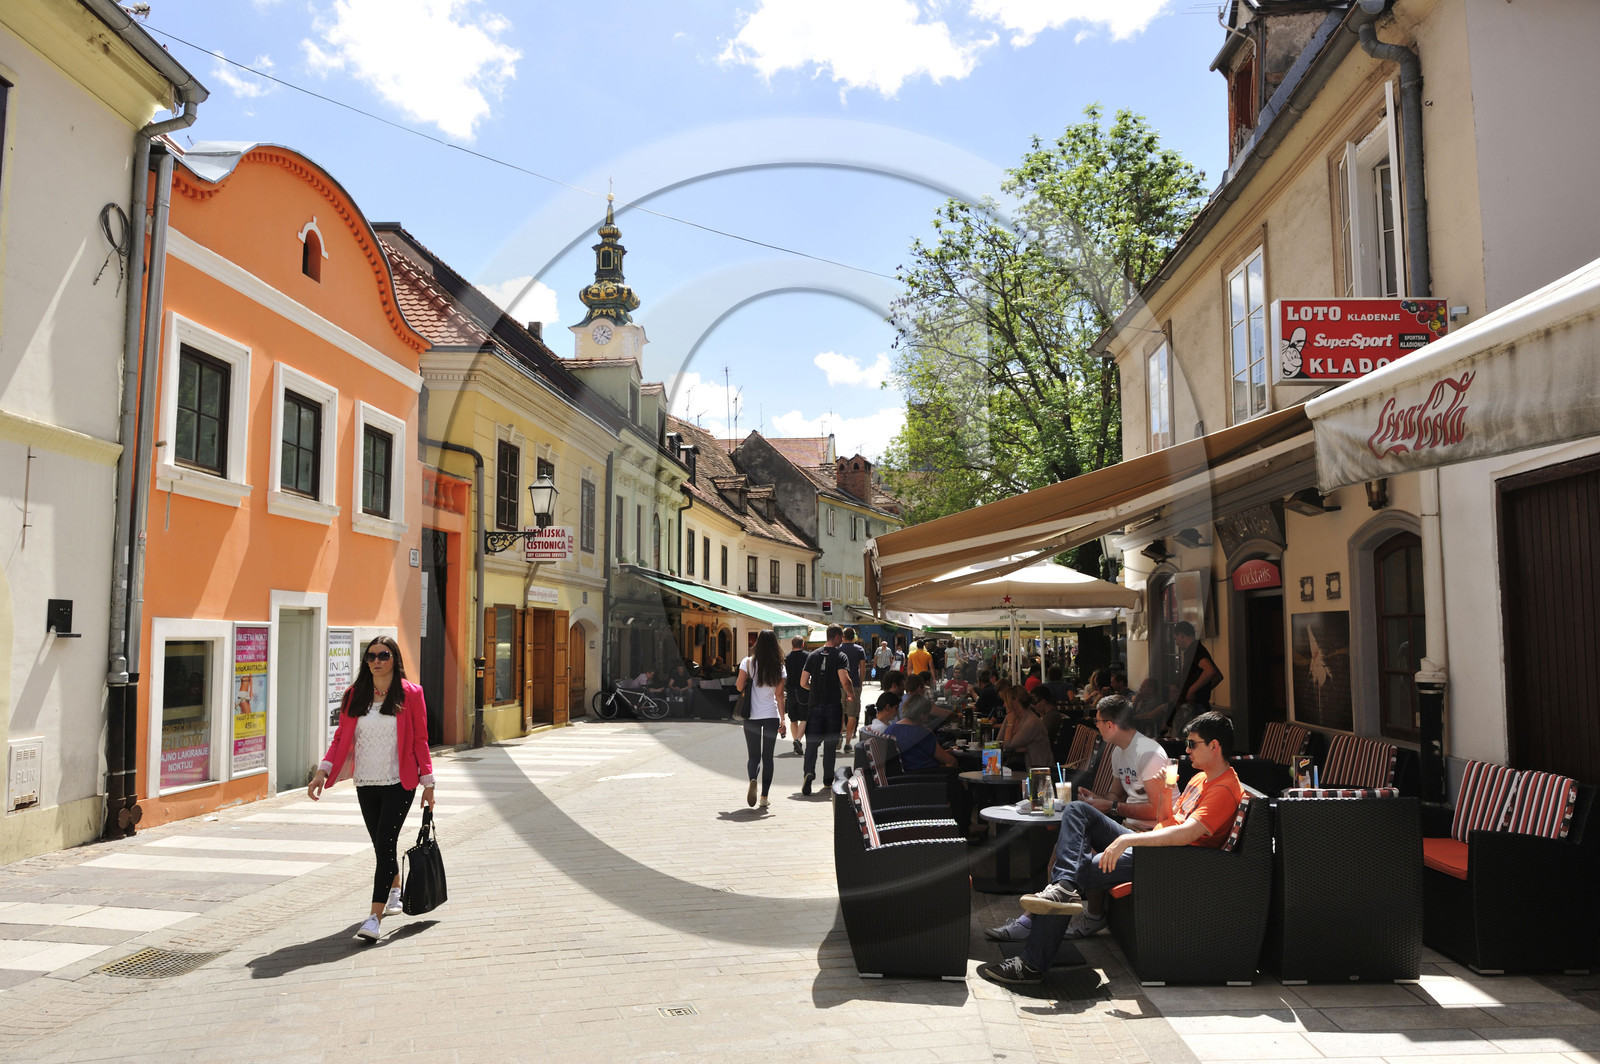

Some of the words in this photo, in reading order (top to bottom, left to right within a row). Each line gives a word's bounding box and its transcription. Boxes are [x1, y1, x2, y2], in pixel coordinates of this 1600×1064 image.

[1287, 306, 1341, 321] LOTO
[1347, 313, 1400, 321] KLAĐENJE
[1313, 333, 1393, 349] SuperSport
[1309, 358, 1400, 373] KLADO
[1240, 567, 1271, 586] cocktails
[329, 648, 351, 656] AKCIJA
[178, 747, 208, 759] LAKIRANJE
[168, 760, 193, 772] NOKTIJU
[16, 769, 35, 784] PLIN
